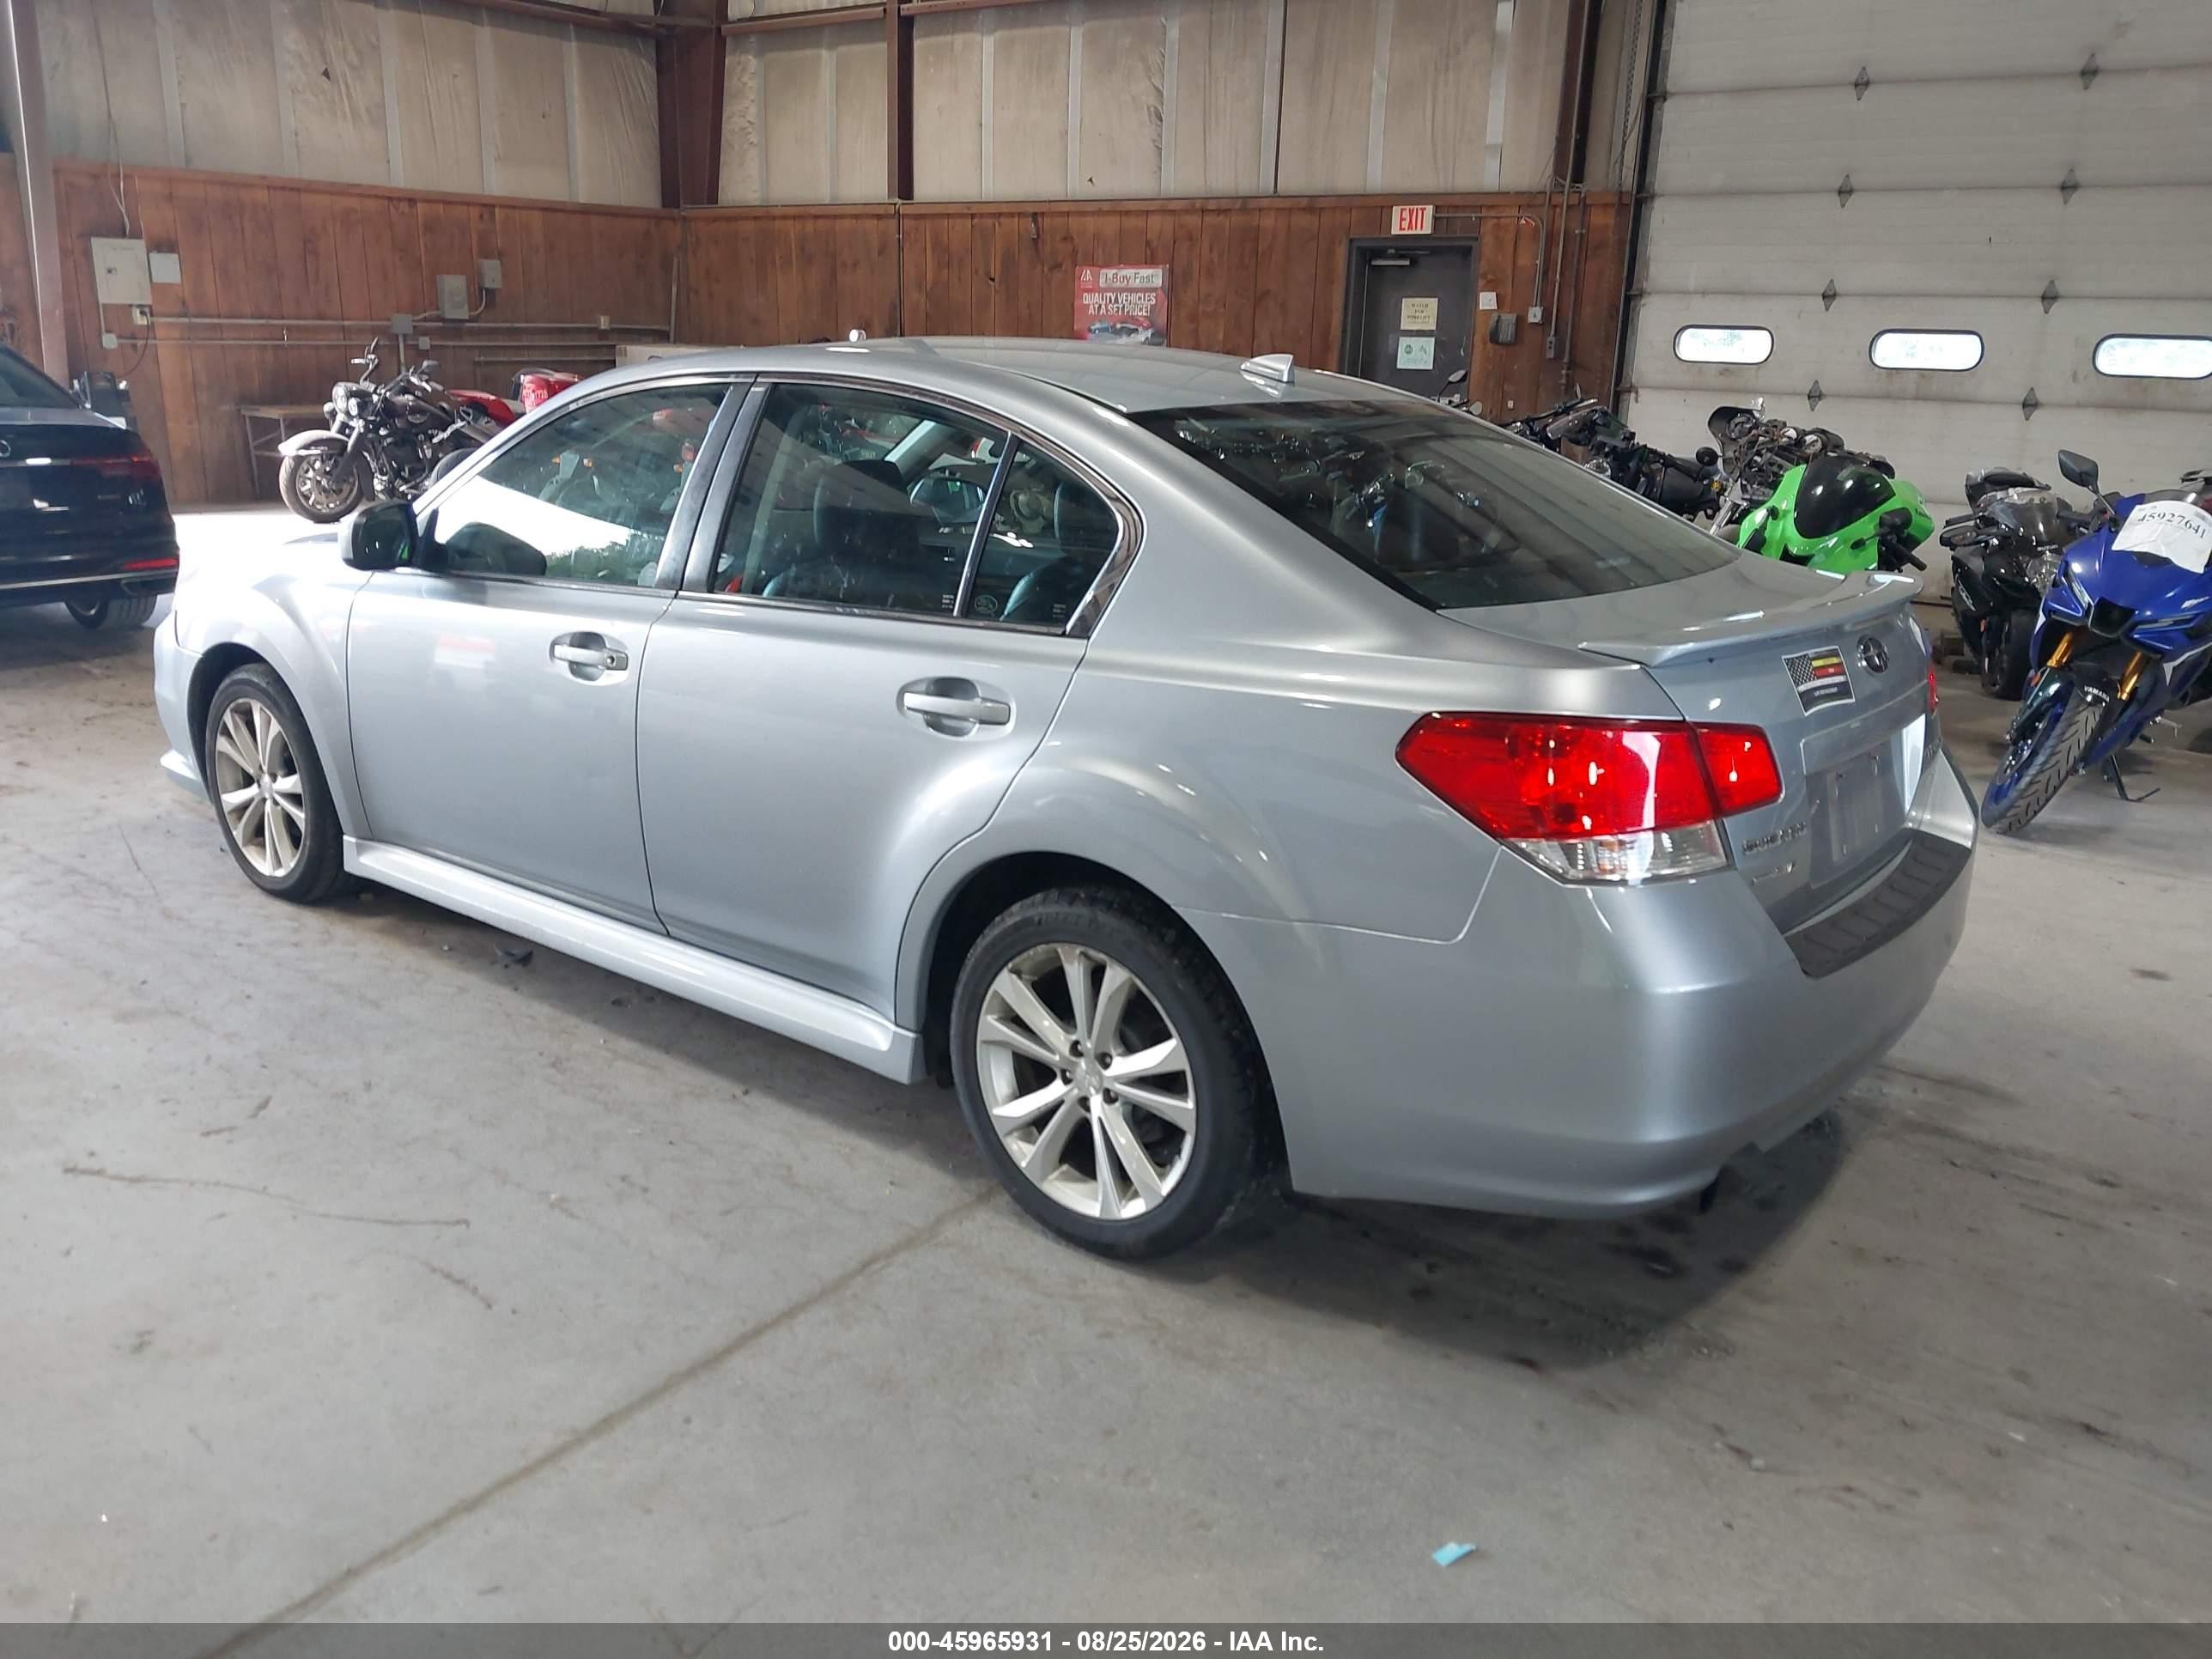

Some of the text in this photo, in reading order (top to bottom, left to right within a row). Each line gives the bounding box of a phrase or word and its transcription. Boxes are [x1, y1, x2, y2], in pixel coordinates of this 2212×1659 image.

[1399, 207, 1426, 231] EXIT
[1133, 272, 1154, 283] Fast
[1083, 292, 1156, 305] QUALITY VEHICLES
[1089, 304, 1151, 316] AT A SET PRICE!
[2137, 512, 2206, 539] 45927641
